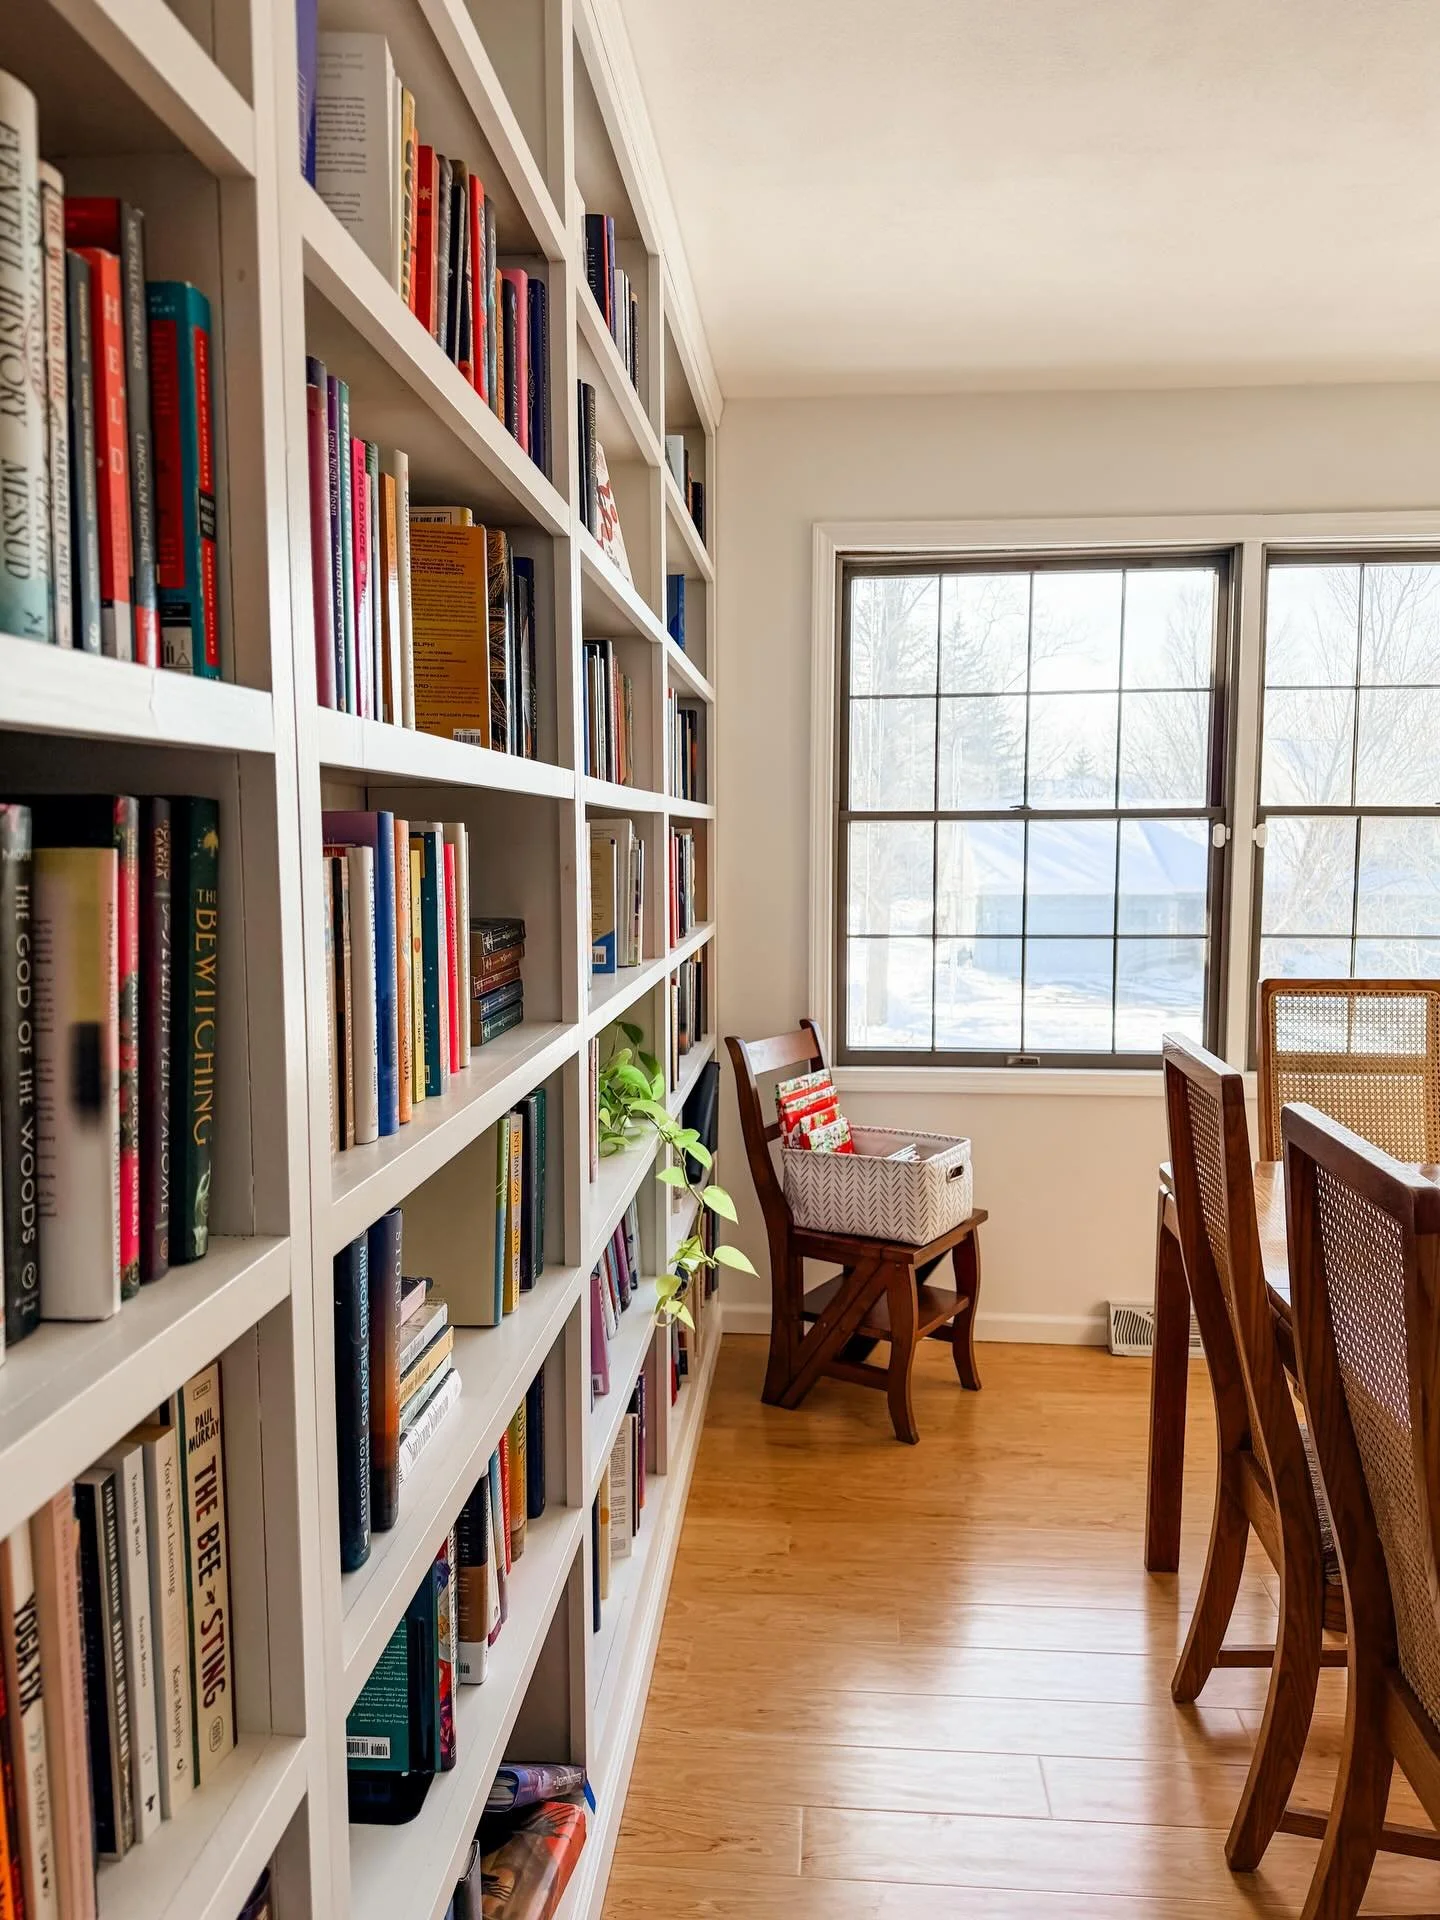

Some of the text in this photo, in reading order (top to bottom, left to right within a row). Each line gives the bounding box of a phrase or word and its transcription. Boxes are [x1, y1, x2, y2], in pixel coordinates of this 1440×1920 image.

[0, 285, 28, 427] HISTORY
[48, 196, 68, 401] THE WITCHING TIDE
[128, 220, 145, 370] METALLIC REALMS
[136, 432, 153, 564] LINCOLN MICHEL
[328, 429, 338, 454] Long
[329, 458, 338, 486] Night
[331, 488, 339, 516] Moon
[1, 459, 31, 581] MESSUD
[56, 438, 73, 606] MARGARET MEYER
[357, 456, 368, 553] STAG DANCE
[206, 546, 214, 608] MADELINE
[155, 827, 165, 879] GARCIA
[15, 885, 36, 1244] THE GOD OF THE WOODS
[192, 907, 217, 1146] BEWITCHING
[359, 1246, 370, 1425] MIRRORED HEAVENS
[189, 1420, 220, 1455] MURRAY
[195, 1408, 214, 1425] PAUL
[131, 1473, 142, 1557] Vanishing World
[163, 1457, 177, 1596] You're Not Listening
[359, 1437, 367, 1524] ROANHORSE
[105, 1485, 120, 1615] FIRST PERSON SINGULAR
[194, 1456, 226, 1709] THE BEE STING
[13, 1592, 44, 1717] YOGA FIX
[113, 1619, 129, 1762] HARUKI MURAKAMI
[141, 1651, 149, 1688] Murata
[172, 1664, 184, 1748] Kate Murphy
